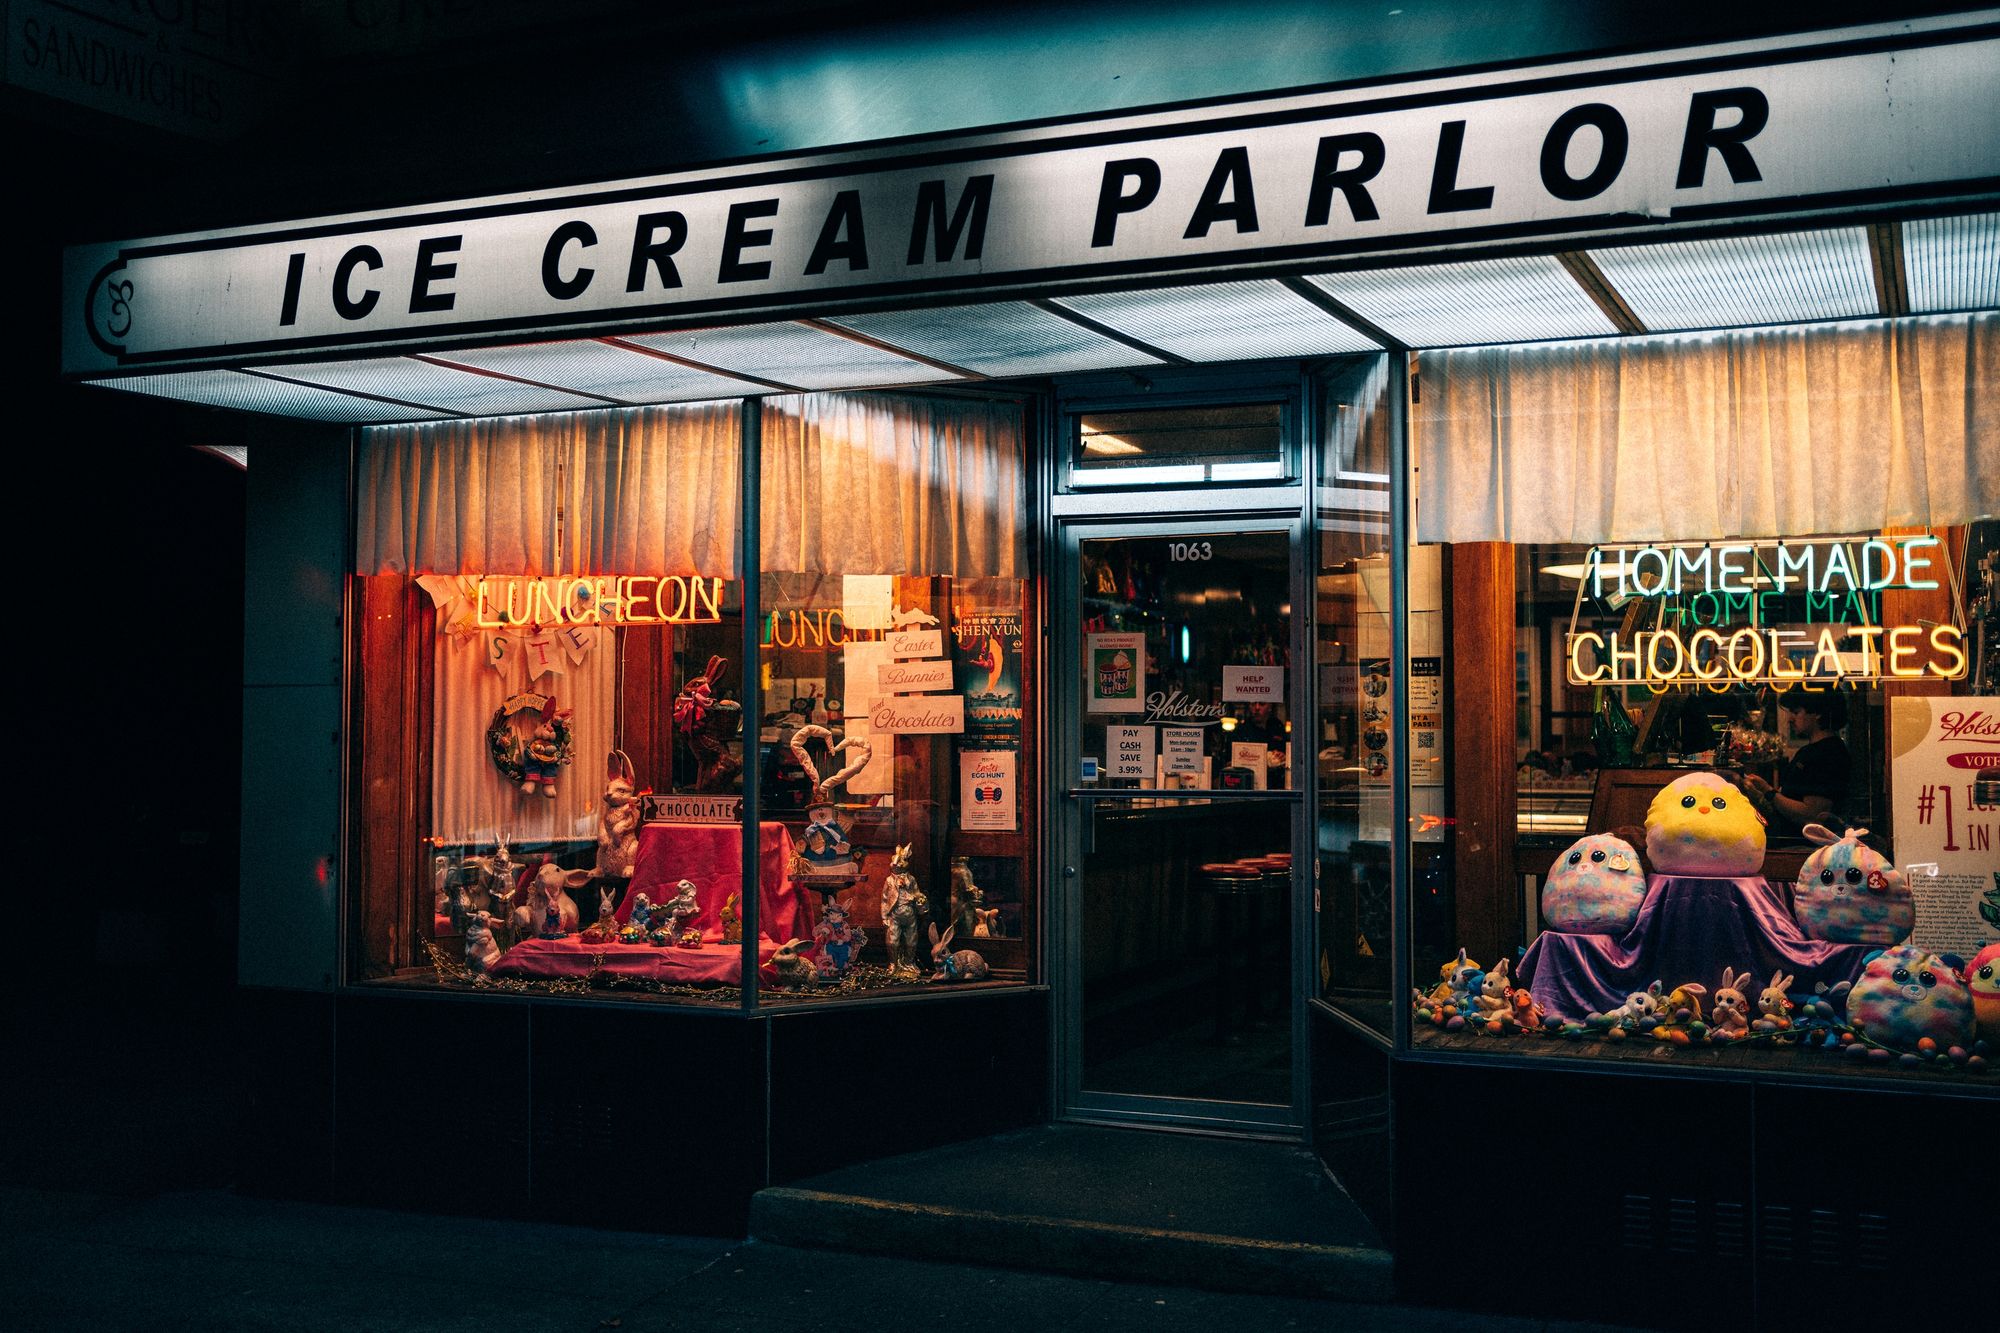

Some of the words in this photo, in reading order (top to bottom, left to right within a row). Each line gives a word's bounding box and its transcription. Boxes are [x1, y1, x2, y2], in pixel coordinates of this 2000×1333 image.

[22, 17, 224, 123] SANDWICHES
[279, 234, 463, 327] ICE
[541, 173, 995, 301] CREAM
[1091, 86, 1770, 249] PARLOR
[1169, 542, 1213, 562] 1063
[1593, 545, 1754, 598] HOME
[1777, 538, 1940, 593] MADE
[477, 575, 722, 628] LUNCHEON
[998, 617, 1015, 625] 2024
[955, 624, 991, 636] SHEN
[994, 624, 1022, 636] YUN
[893, 635, 936, 653] Easter
[1572, 624, 1966, 682] CHOCOLATES
[884, 668, 945, 685] Bunnies
[1242, 675, 1264, 683] HELP
[1235, 685, 1271, 693] WANTED
[871, 698, 885, 713] and
[1145, 691, 1228, 727] Holsten's
[874, 708, 955, 729] Chocolates
[1123, 729, 1139, 737] PAY
[1120, 741, 1141, 750] CASH
[1120, 753, 1141, 762] SAVE
[1118, 765, 1143, 774] 3.99%
[659, 803, 732, 817] CHOCOLATE
[1917, 784, 1961, 852] #1
[1968, 823, 1990, 851] IN
